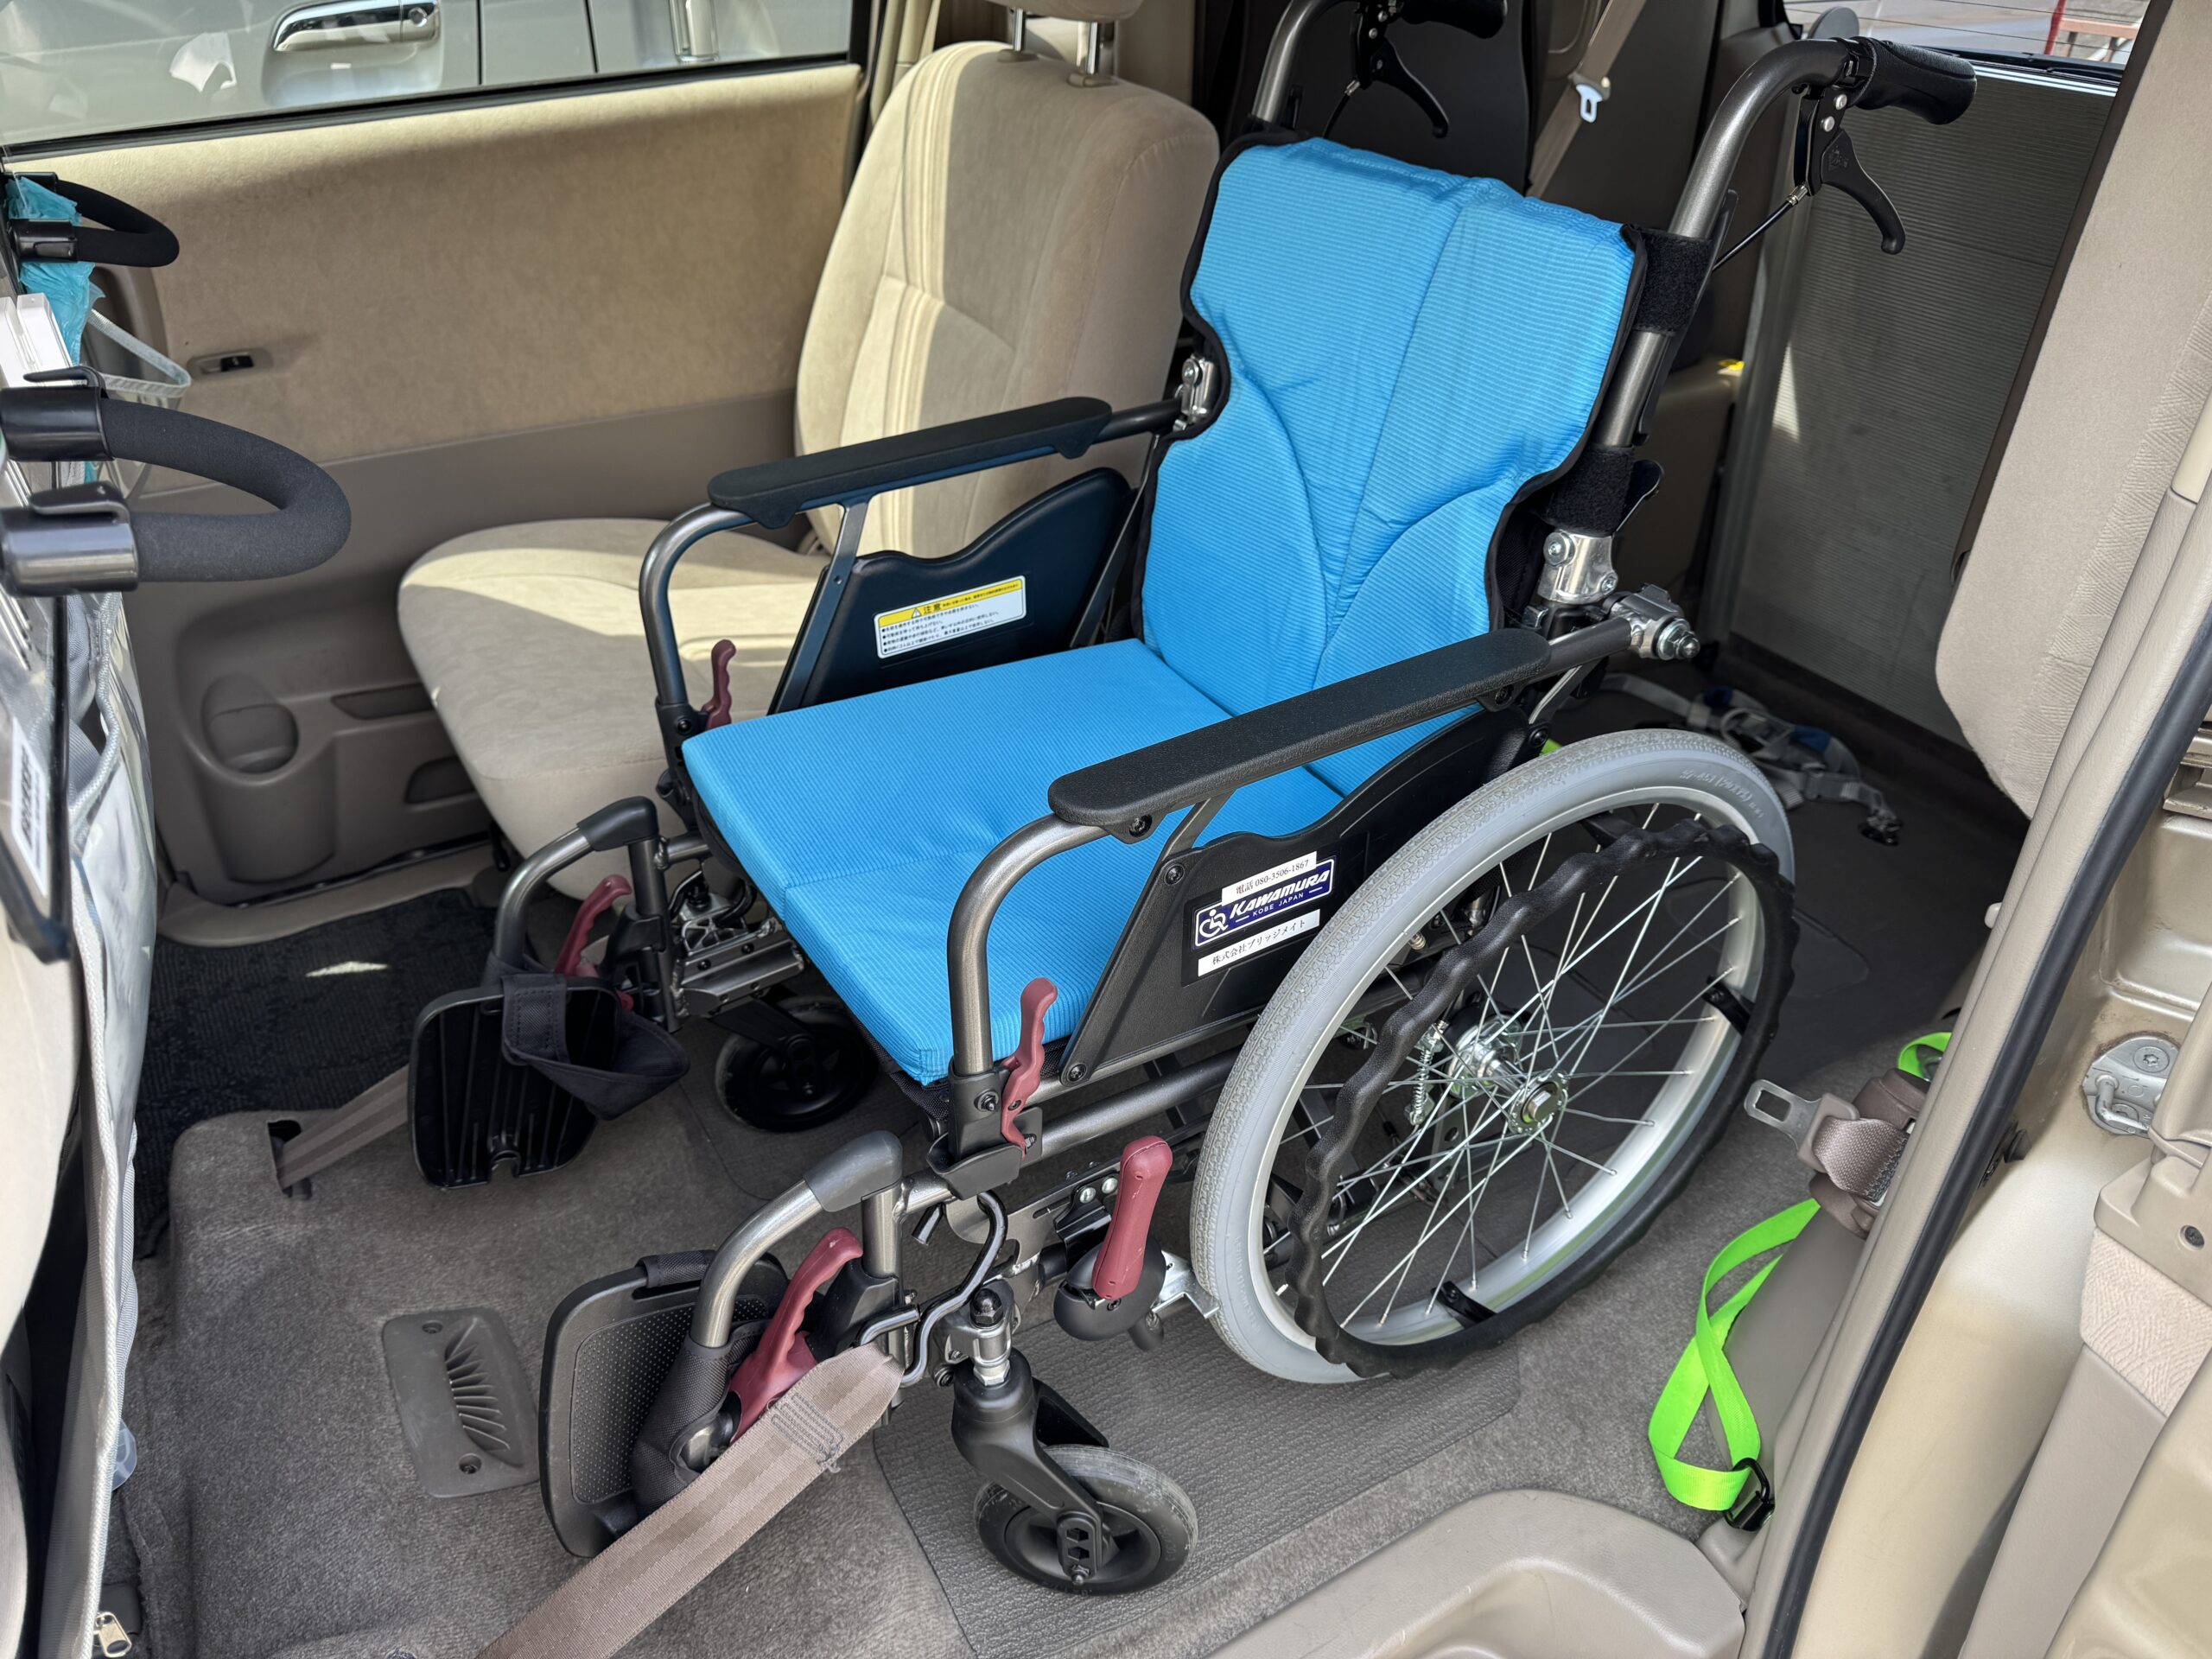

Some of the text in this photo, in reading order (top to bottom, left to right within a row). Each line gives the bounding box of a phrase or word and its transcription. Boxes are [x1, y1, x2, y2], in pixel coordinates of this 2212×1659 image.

[1236, 859, 1309, 894] 電話 080-3506-1867
[1230, 870, 1330, 919] KAWAMURA
[1253, 893, 1304, 917] KOBE JAPAN
